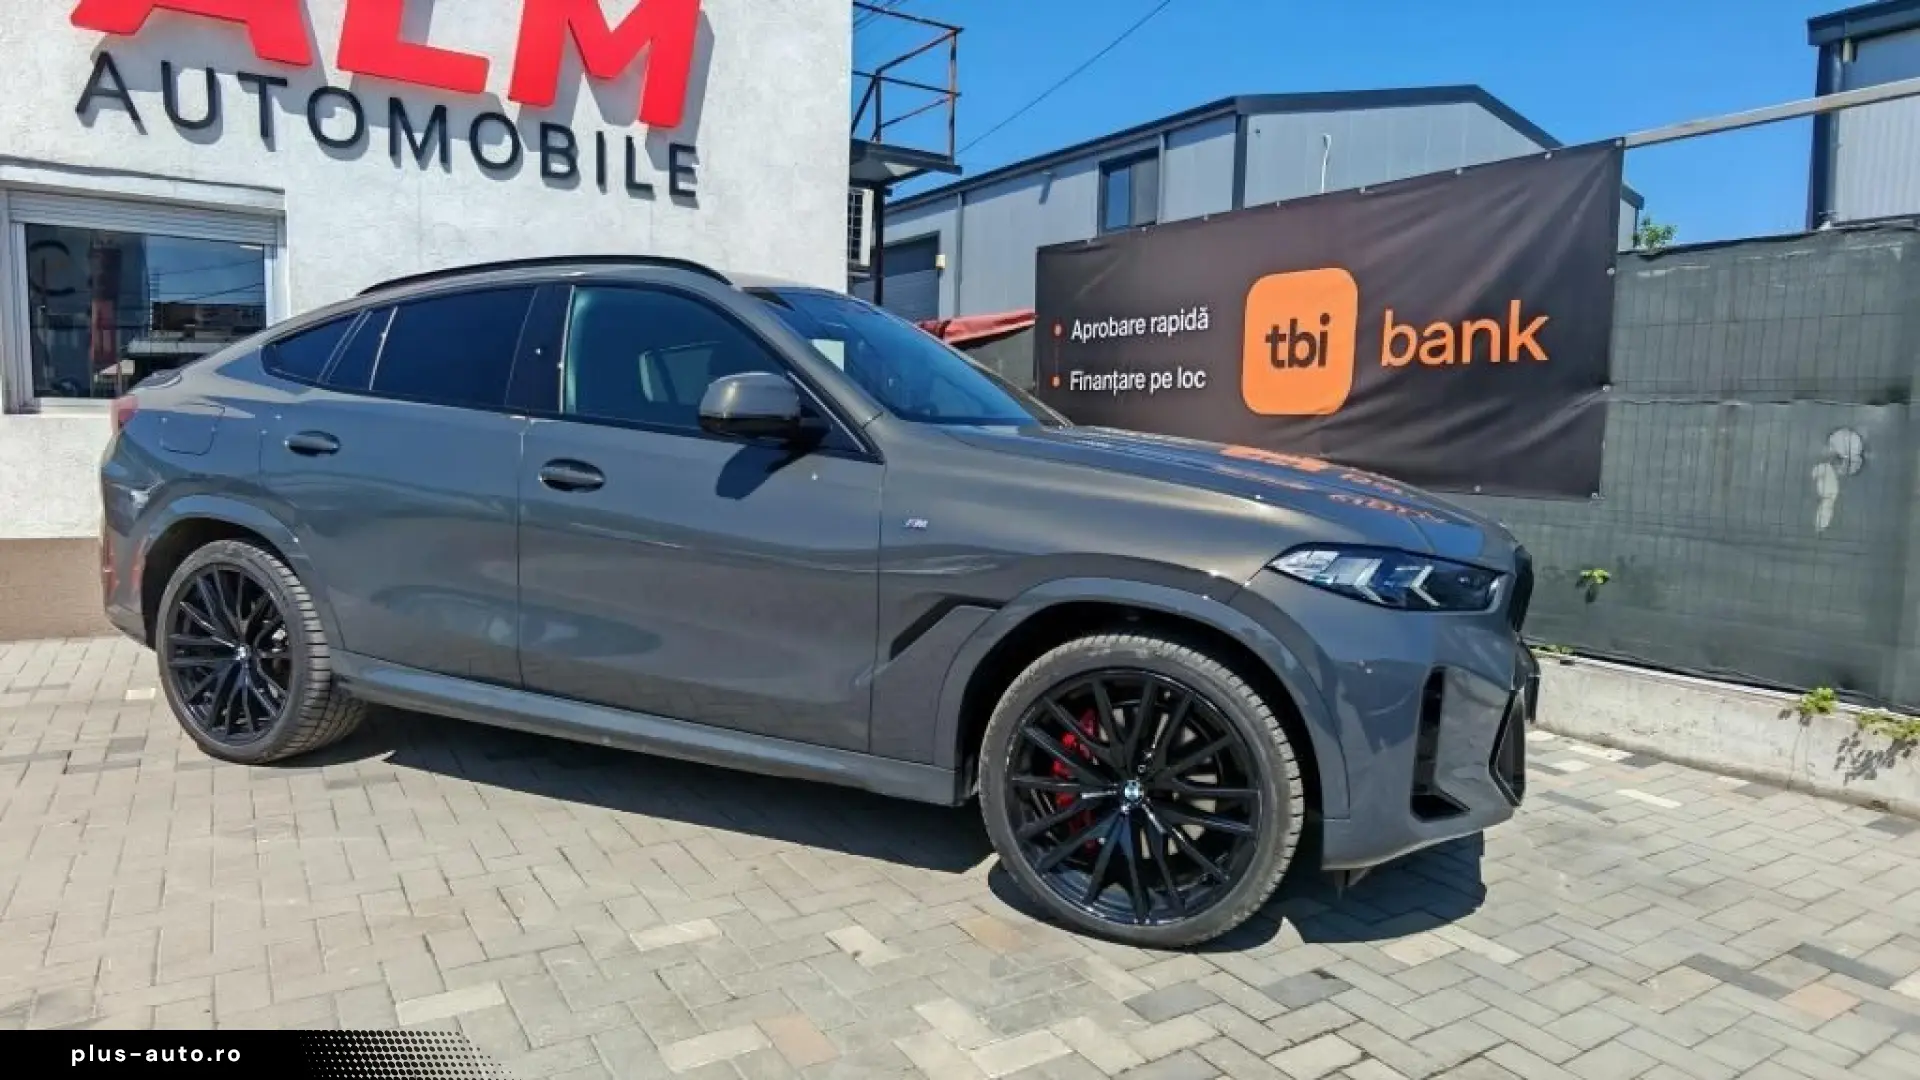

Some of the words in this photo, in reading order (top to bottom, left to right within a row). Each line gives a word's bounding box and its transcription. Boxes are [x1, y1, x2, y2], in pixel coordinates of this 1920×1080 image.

[75, 51, 699, 198] AUTOMOBILE
[1070, 316, 1147, 344] Aprobare
[1150, 306, 1209, 337] rapidă
[1265, 312, 1332, 369] tbi
[1381, 299, 1549, 367] bank
[1069, 369, 1147, 397] Finanțare
[1150, 370, 1173, 396] pe
[1176, 365, 1207, 389] loc
